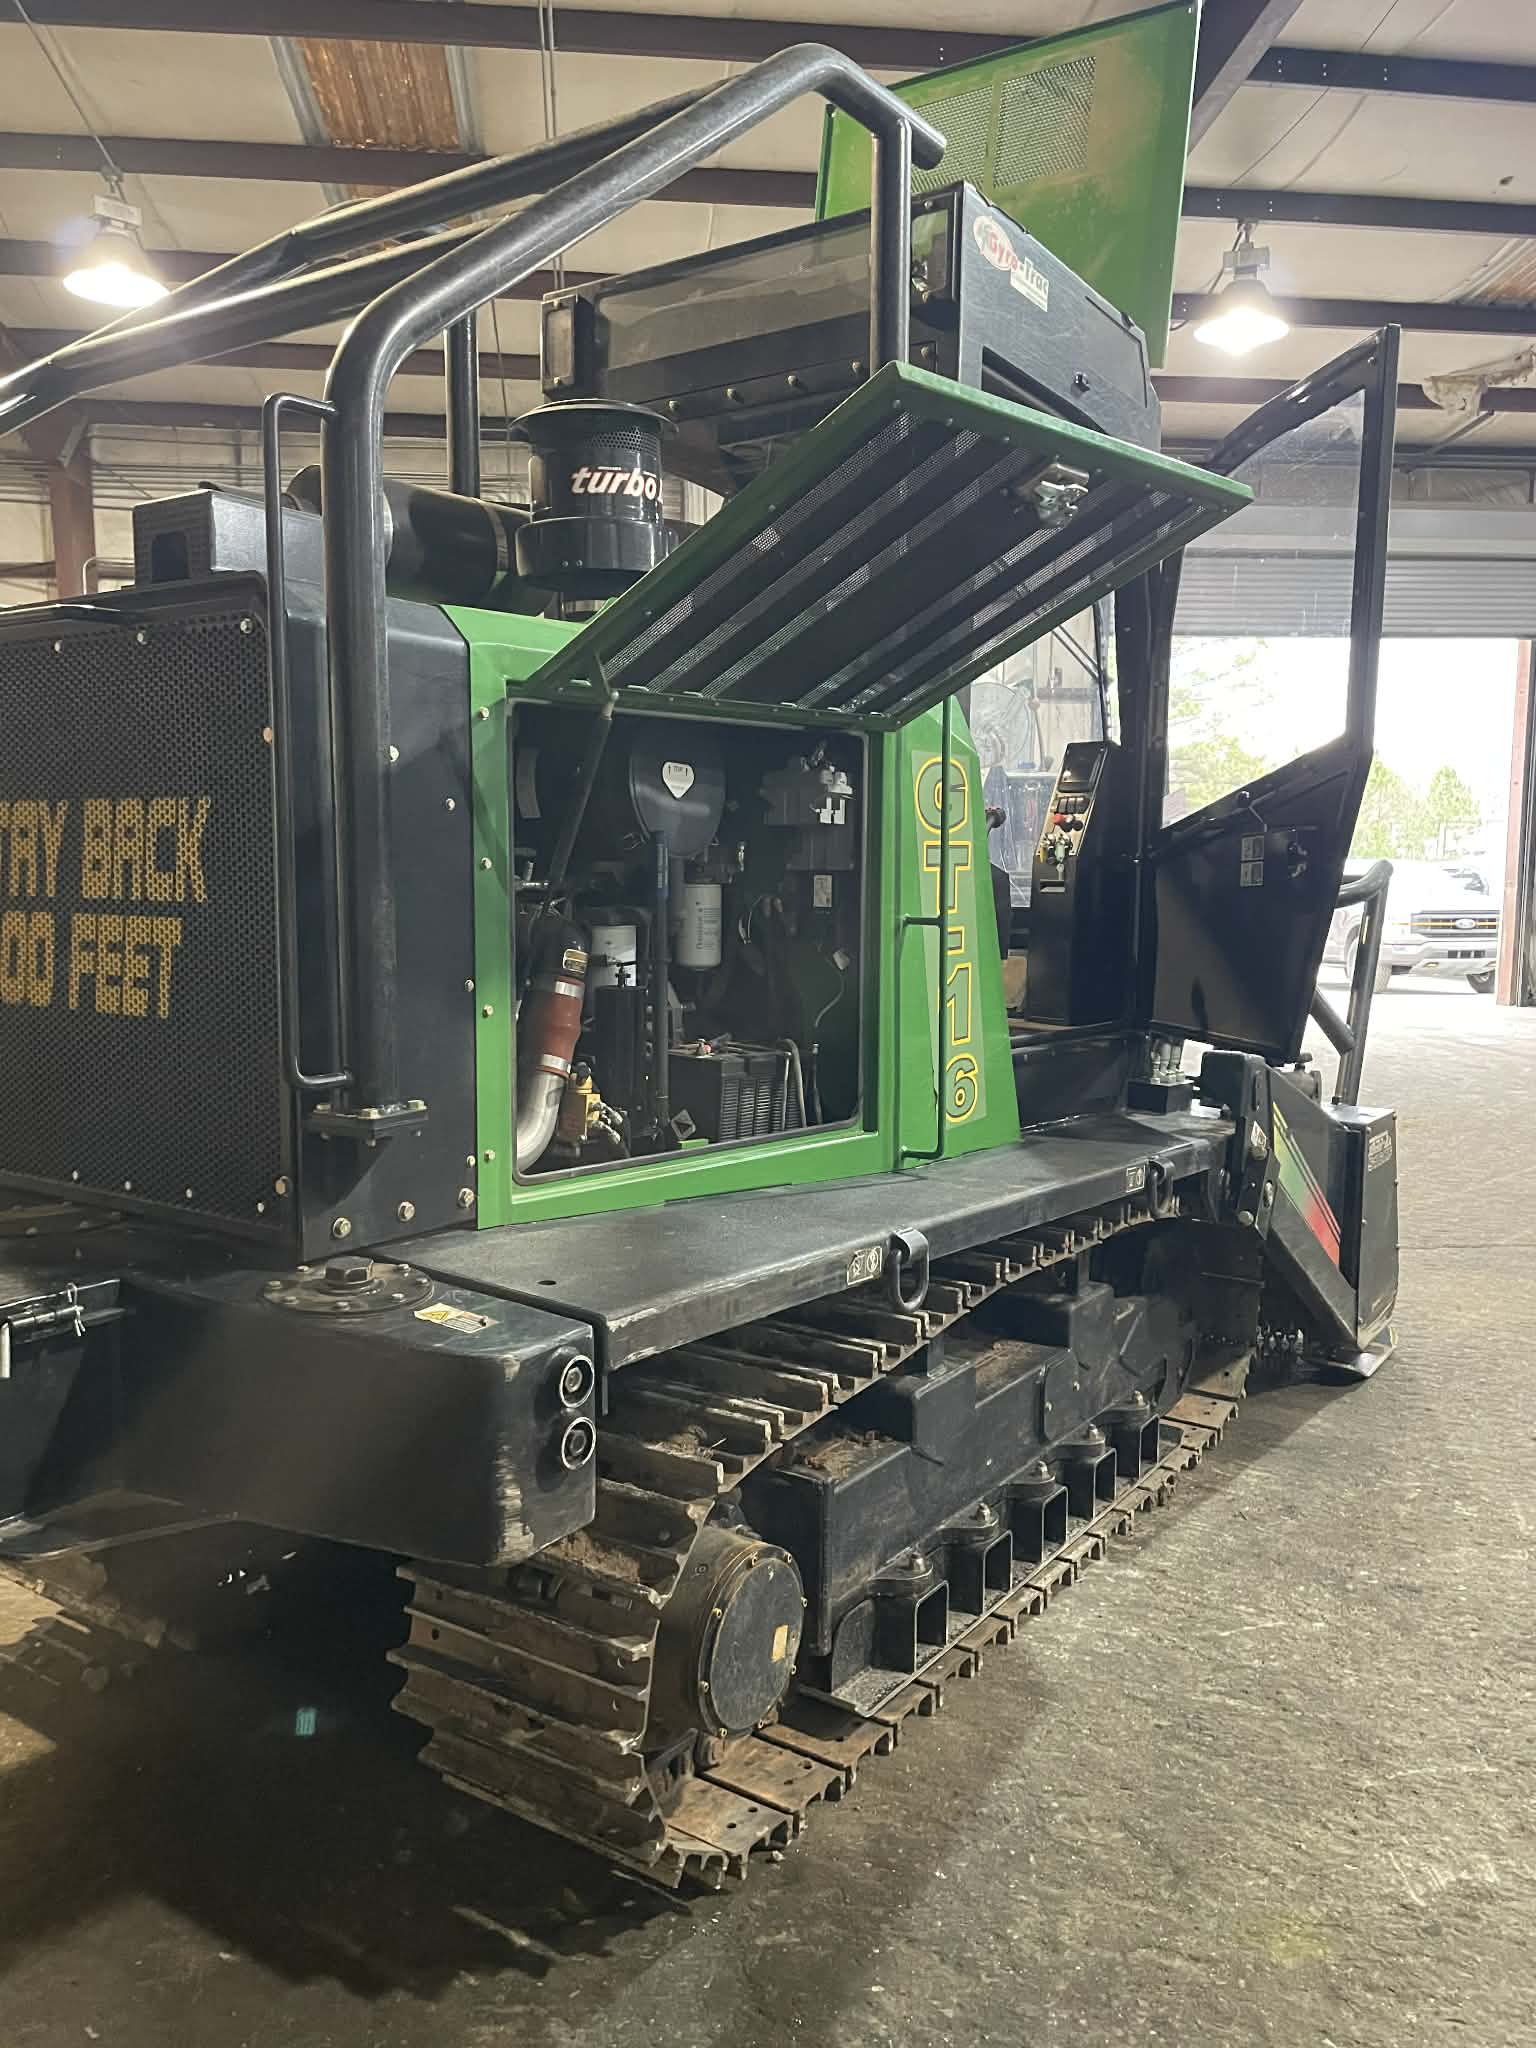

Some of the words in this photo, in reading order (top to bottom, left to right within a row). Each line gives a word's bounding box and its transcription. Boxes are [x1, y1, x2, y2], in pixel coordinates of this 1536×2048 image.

[571, 466, 657, 500] turbo
[82, 798, 211, 903] BACK
[68, 912, 184, 1020] FEET
[914, 756, 979, 1123] GT-16
